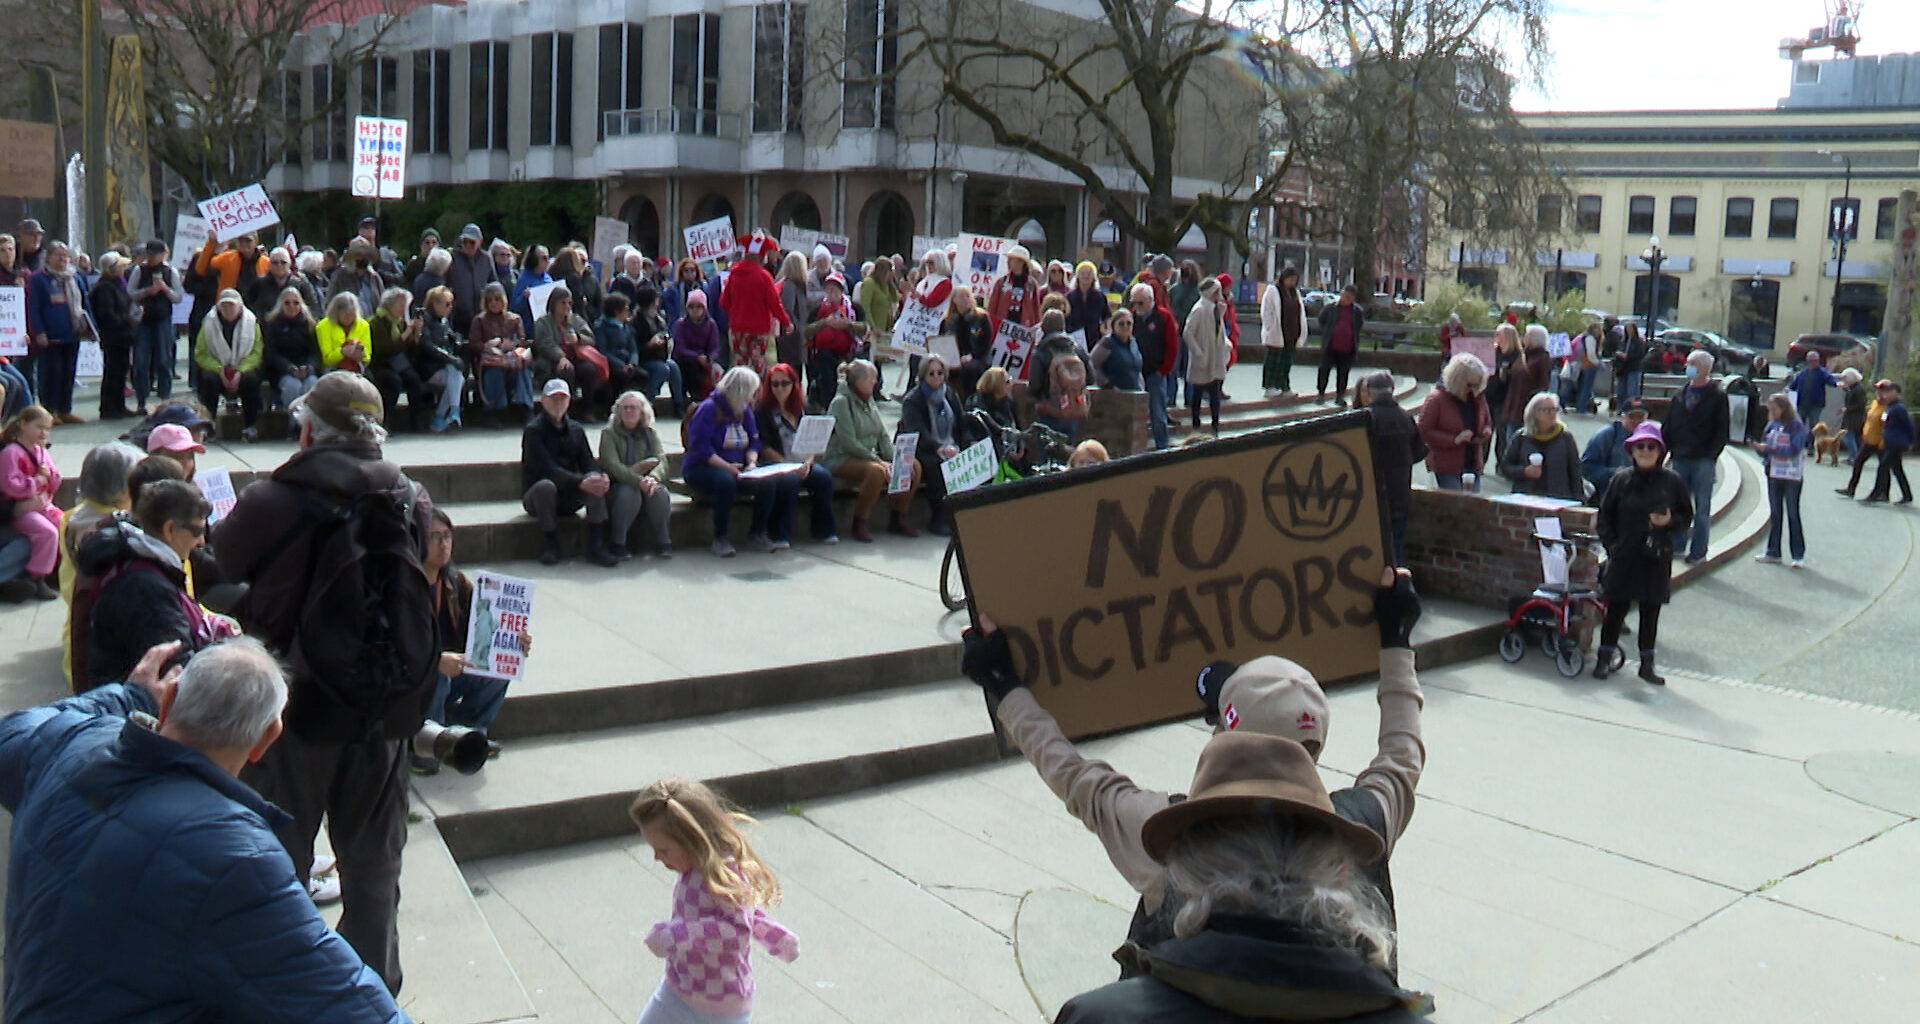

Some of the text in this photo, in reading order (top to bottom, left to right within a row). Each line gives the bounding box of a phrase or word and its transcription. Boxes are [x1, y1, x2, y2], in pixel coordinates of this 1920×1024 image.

[206, 191, 248, 216] FIGHT
[210, 200, 273, 232] FASCISM
[972, 237, 1004, 251] NOT
[971, 271, 992, 285] OK
[992, 347, 1023, 372] UP
[948, 443, 986, 472] DEFEND
[1084, 476, 1248, 589] NO
[503, 583, 526, 598] MAKE
[495, 596, 531, 614] AMERICA
[1003, 545, 1380, 690] DICTATORS
[500, 612, 529, 632] FREE
